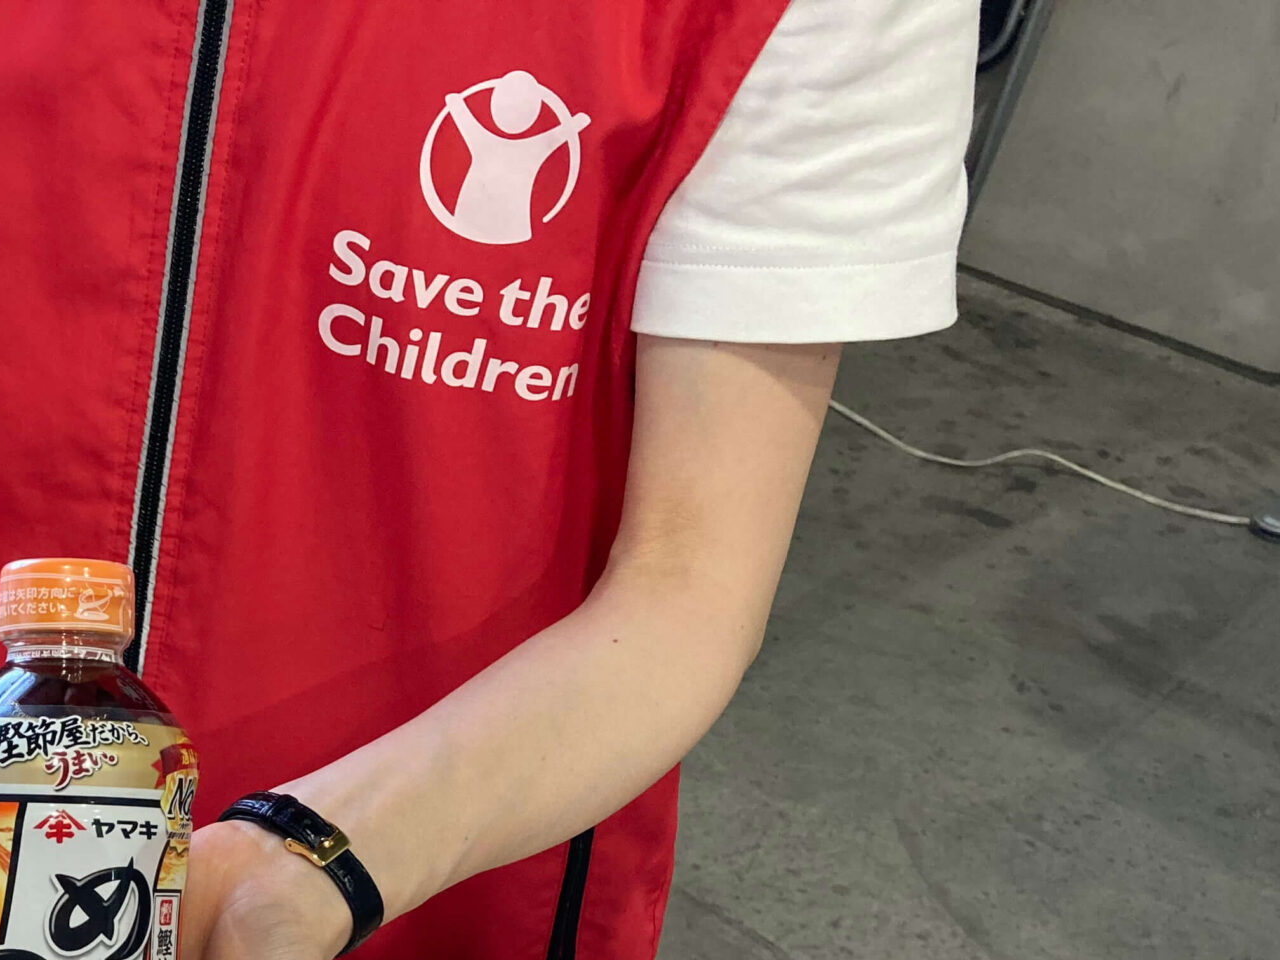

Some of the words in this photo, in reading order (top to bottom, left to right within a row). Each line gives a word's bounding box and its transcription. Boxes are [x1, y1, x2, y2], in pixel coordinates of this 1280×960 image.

[328, 229, 484, 317] Save
[499, 276, 591, 331] the
[318, 303, 579, 402] Children
[44, 749, 115, 788] うまい。
[91, 817, 159, 840] ヤマキ
